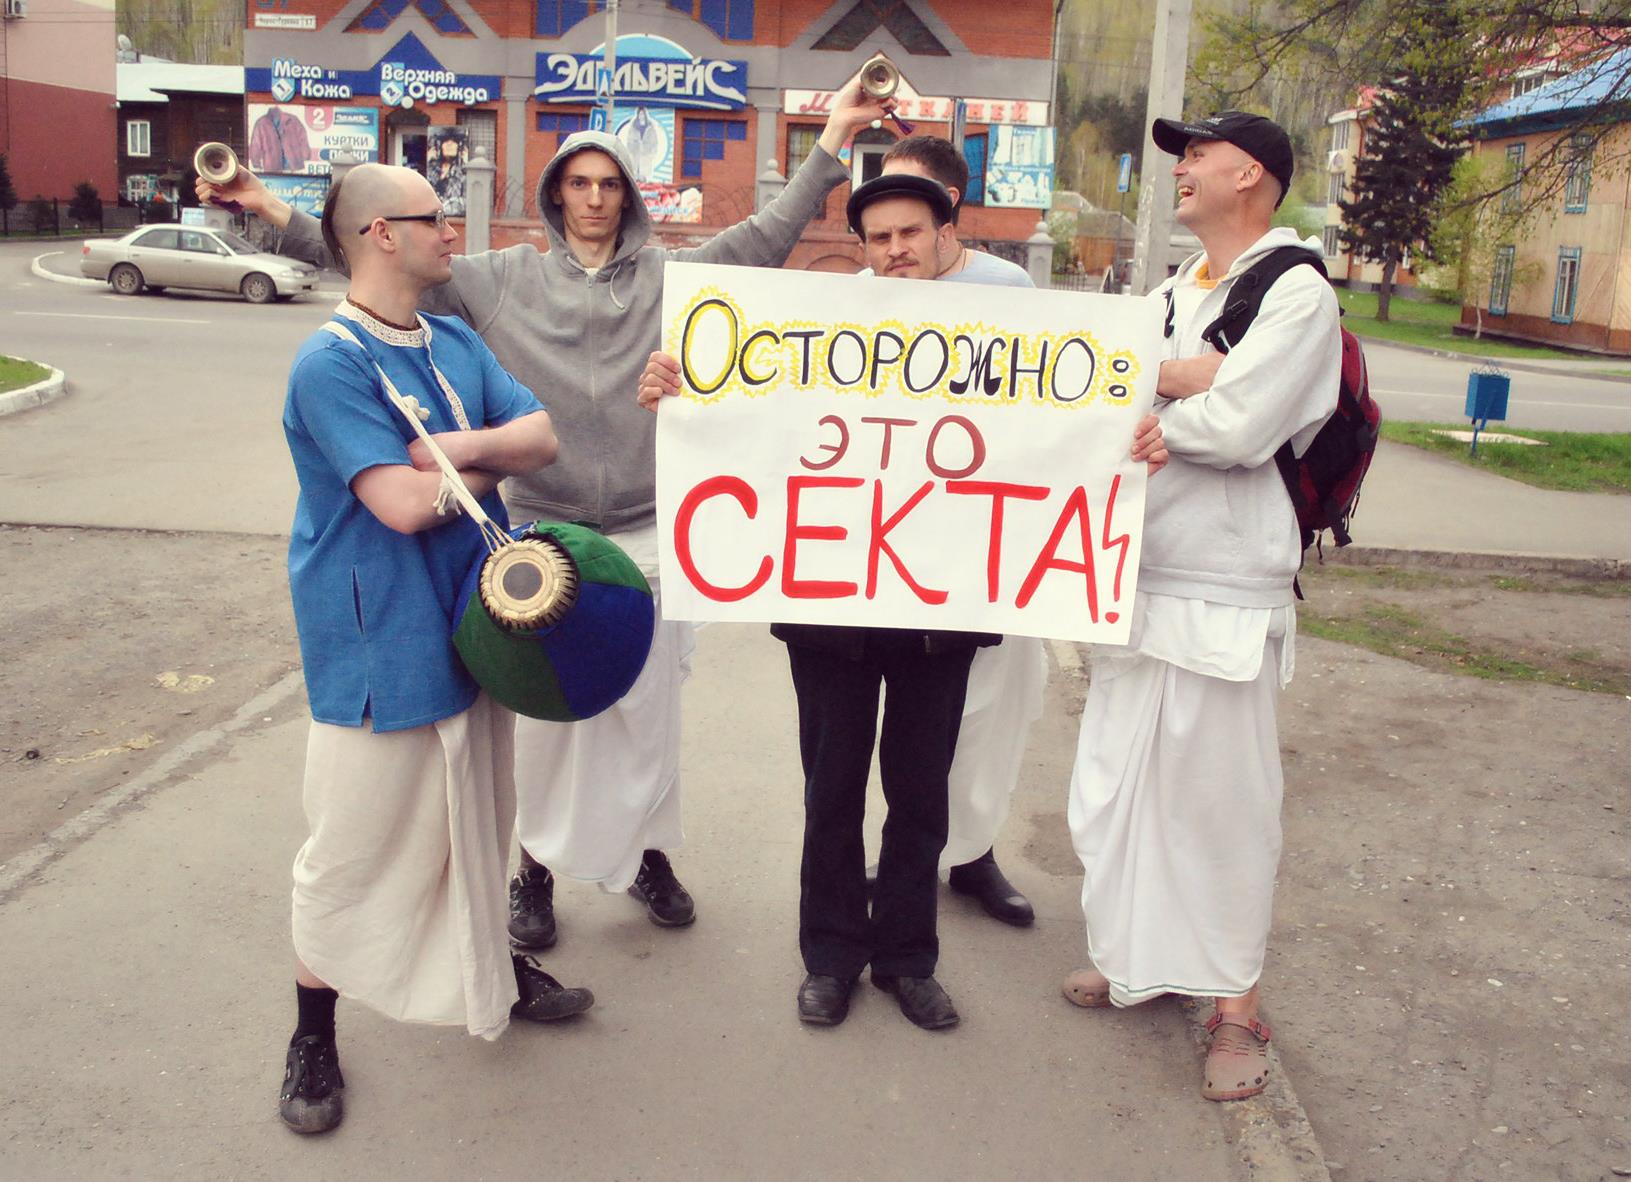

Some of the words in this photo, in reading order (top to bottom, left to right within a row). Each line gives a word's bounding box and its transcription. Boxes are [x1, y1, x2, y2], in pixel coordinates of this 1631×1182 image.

[274, 60, 322, 79] Меха
[328, 70, 336, 80] и
[381, 63, 456, 86] Верхняя
[534, 53, 746, 104] ЭДЛЬВЕЙС
[301, 79, 351, 99] Кожа
[408, 81, 489, 106] Одежда
[313, 107, 326, 125] 2
[324, 135, 369, 147] КУРТКИ
[799, 414, 986, 479] ЭТО
[673, 474, 1131, 625] СЕКТА!
